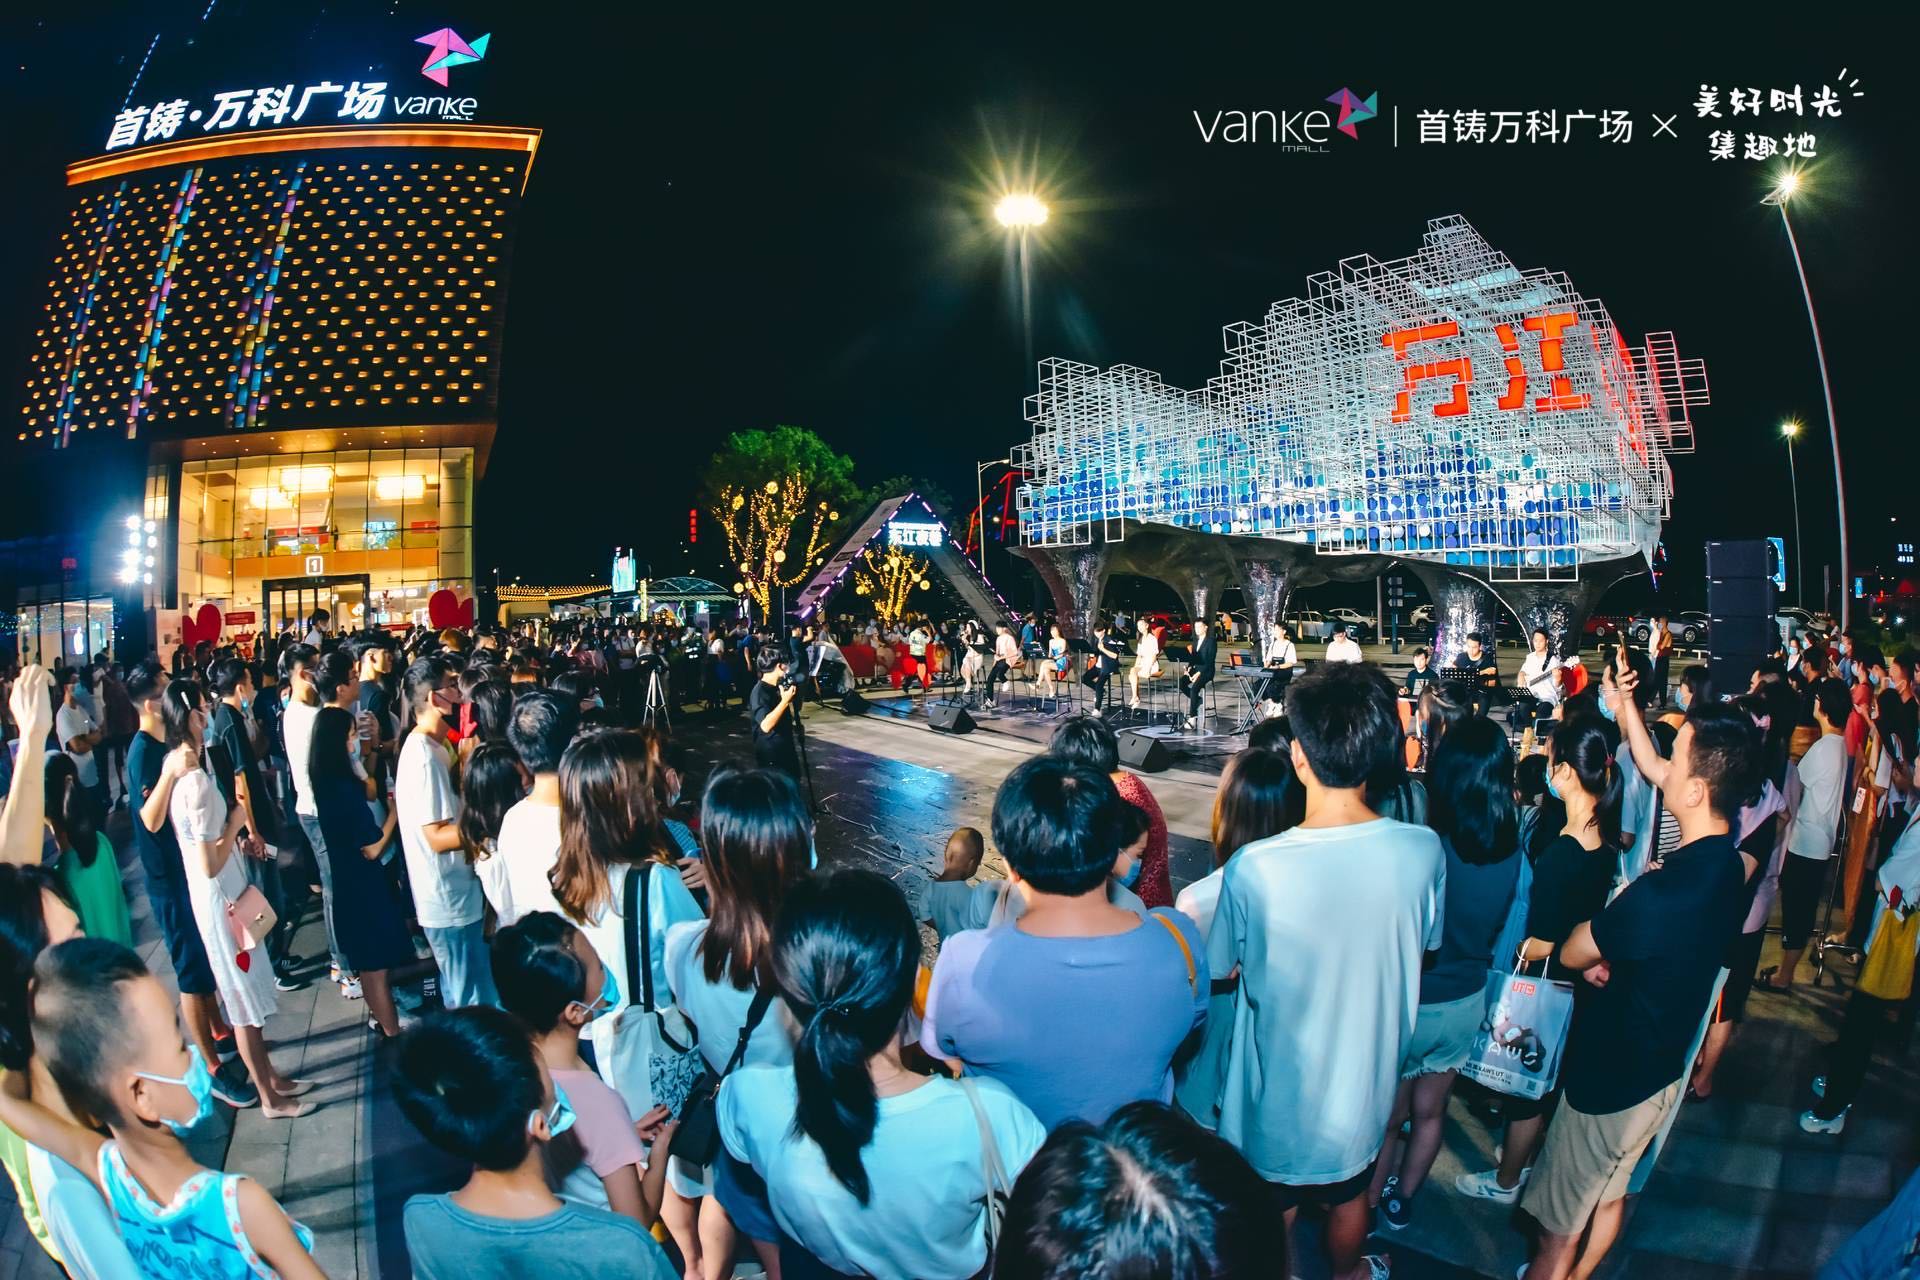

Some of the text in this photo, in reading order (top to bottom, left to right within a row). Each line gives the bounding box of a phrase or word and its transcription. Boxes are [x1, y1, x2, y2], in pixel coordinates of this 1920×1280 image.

[105, 81, 388, 150] 首铸·万科广场
[394, 96, 478, 116] vanke
[1473, 1035, 1538, 1066] KAWS
